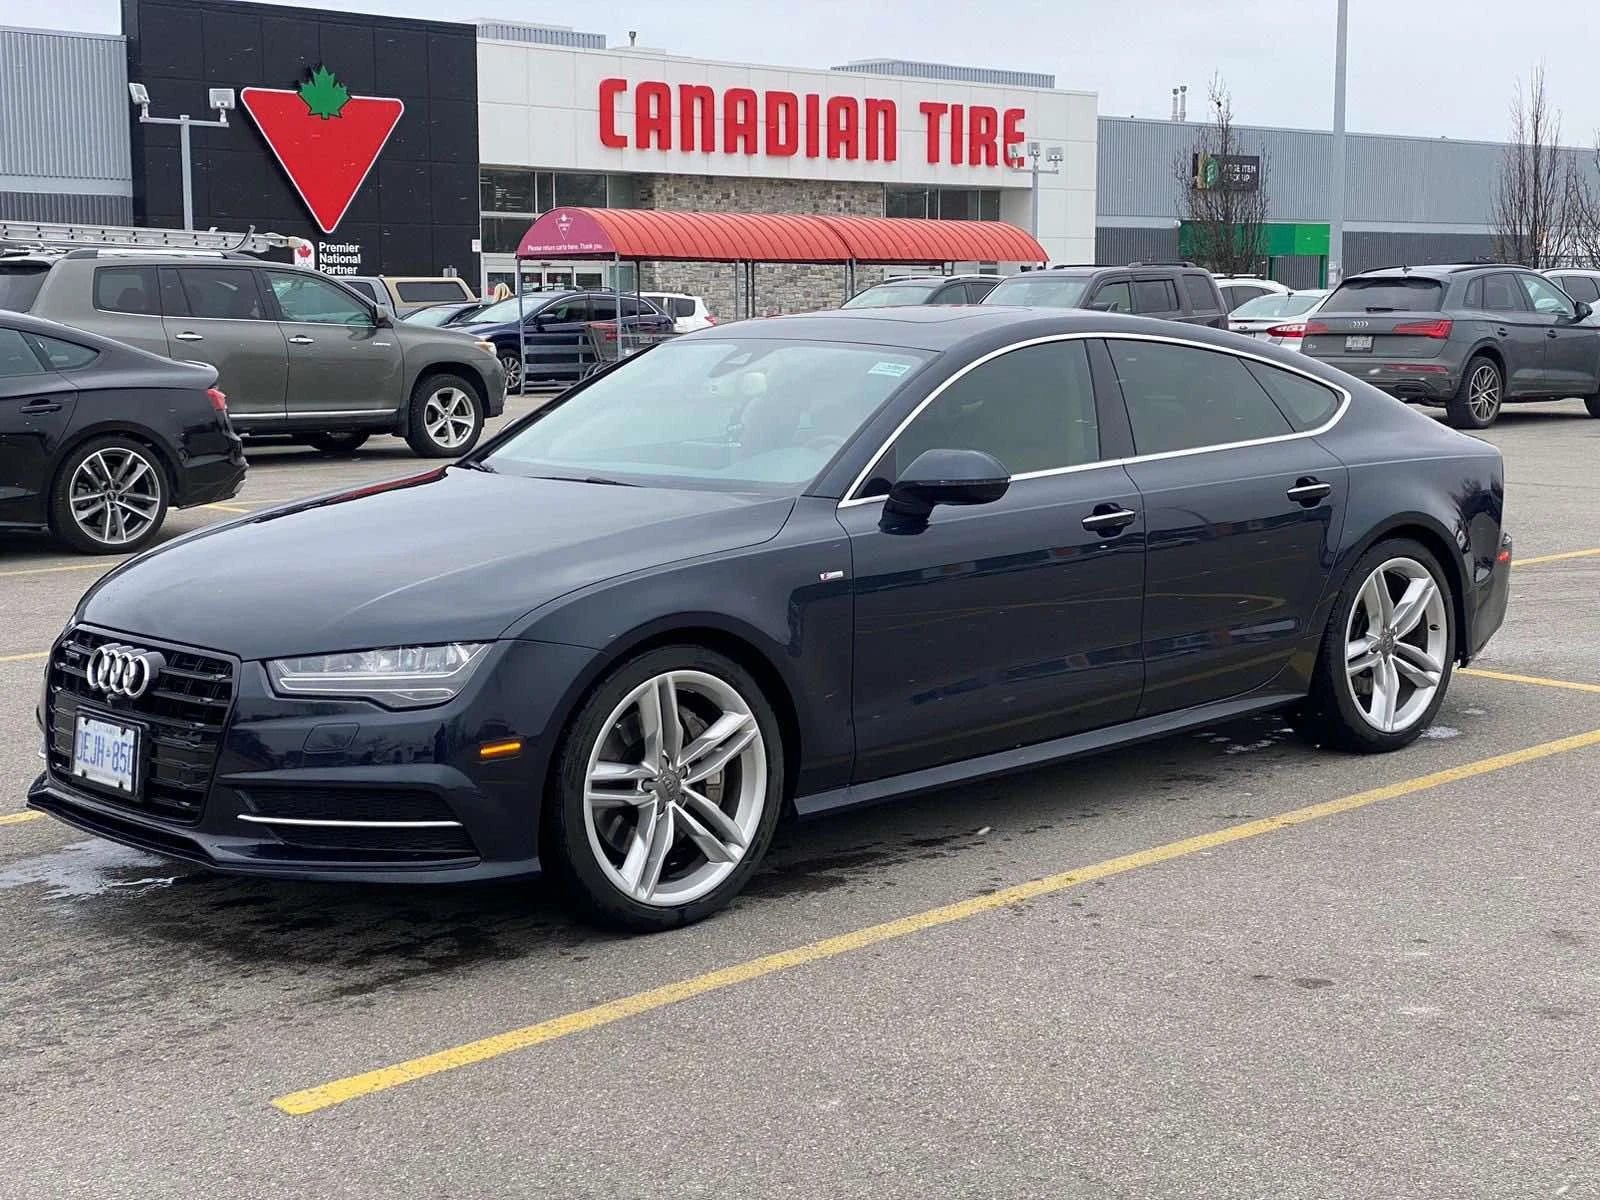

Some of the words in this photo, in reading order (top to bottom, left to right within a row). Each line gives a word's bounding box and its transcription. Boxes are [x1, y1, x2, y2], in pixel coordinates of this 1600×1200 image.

[599, 78, 897, 162] CANADIAN
[919, 101, 1025, 169] TIRE
[1242, 164, 1257, 173] ITEM
[319, 242, 360, 253] Premier
[320, 253, 361, 264] National
[320, 264, 358, 275] Partner
